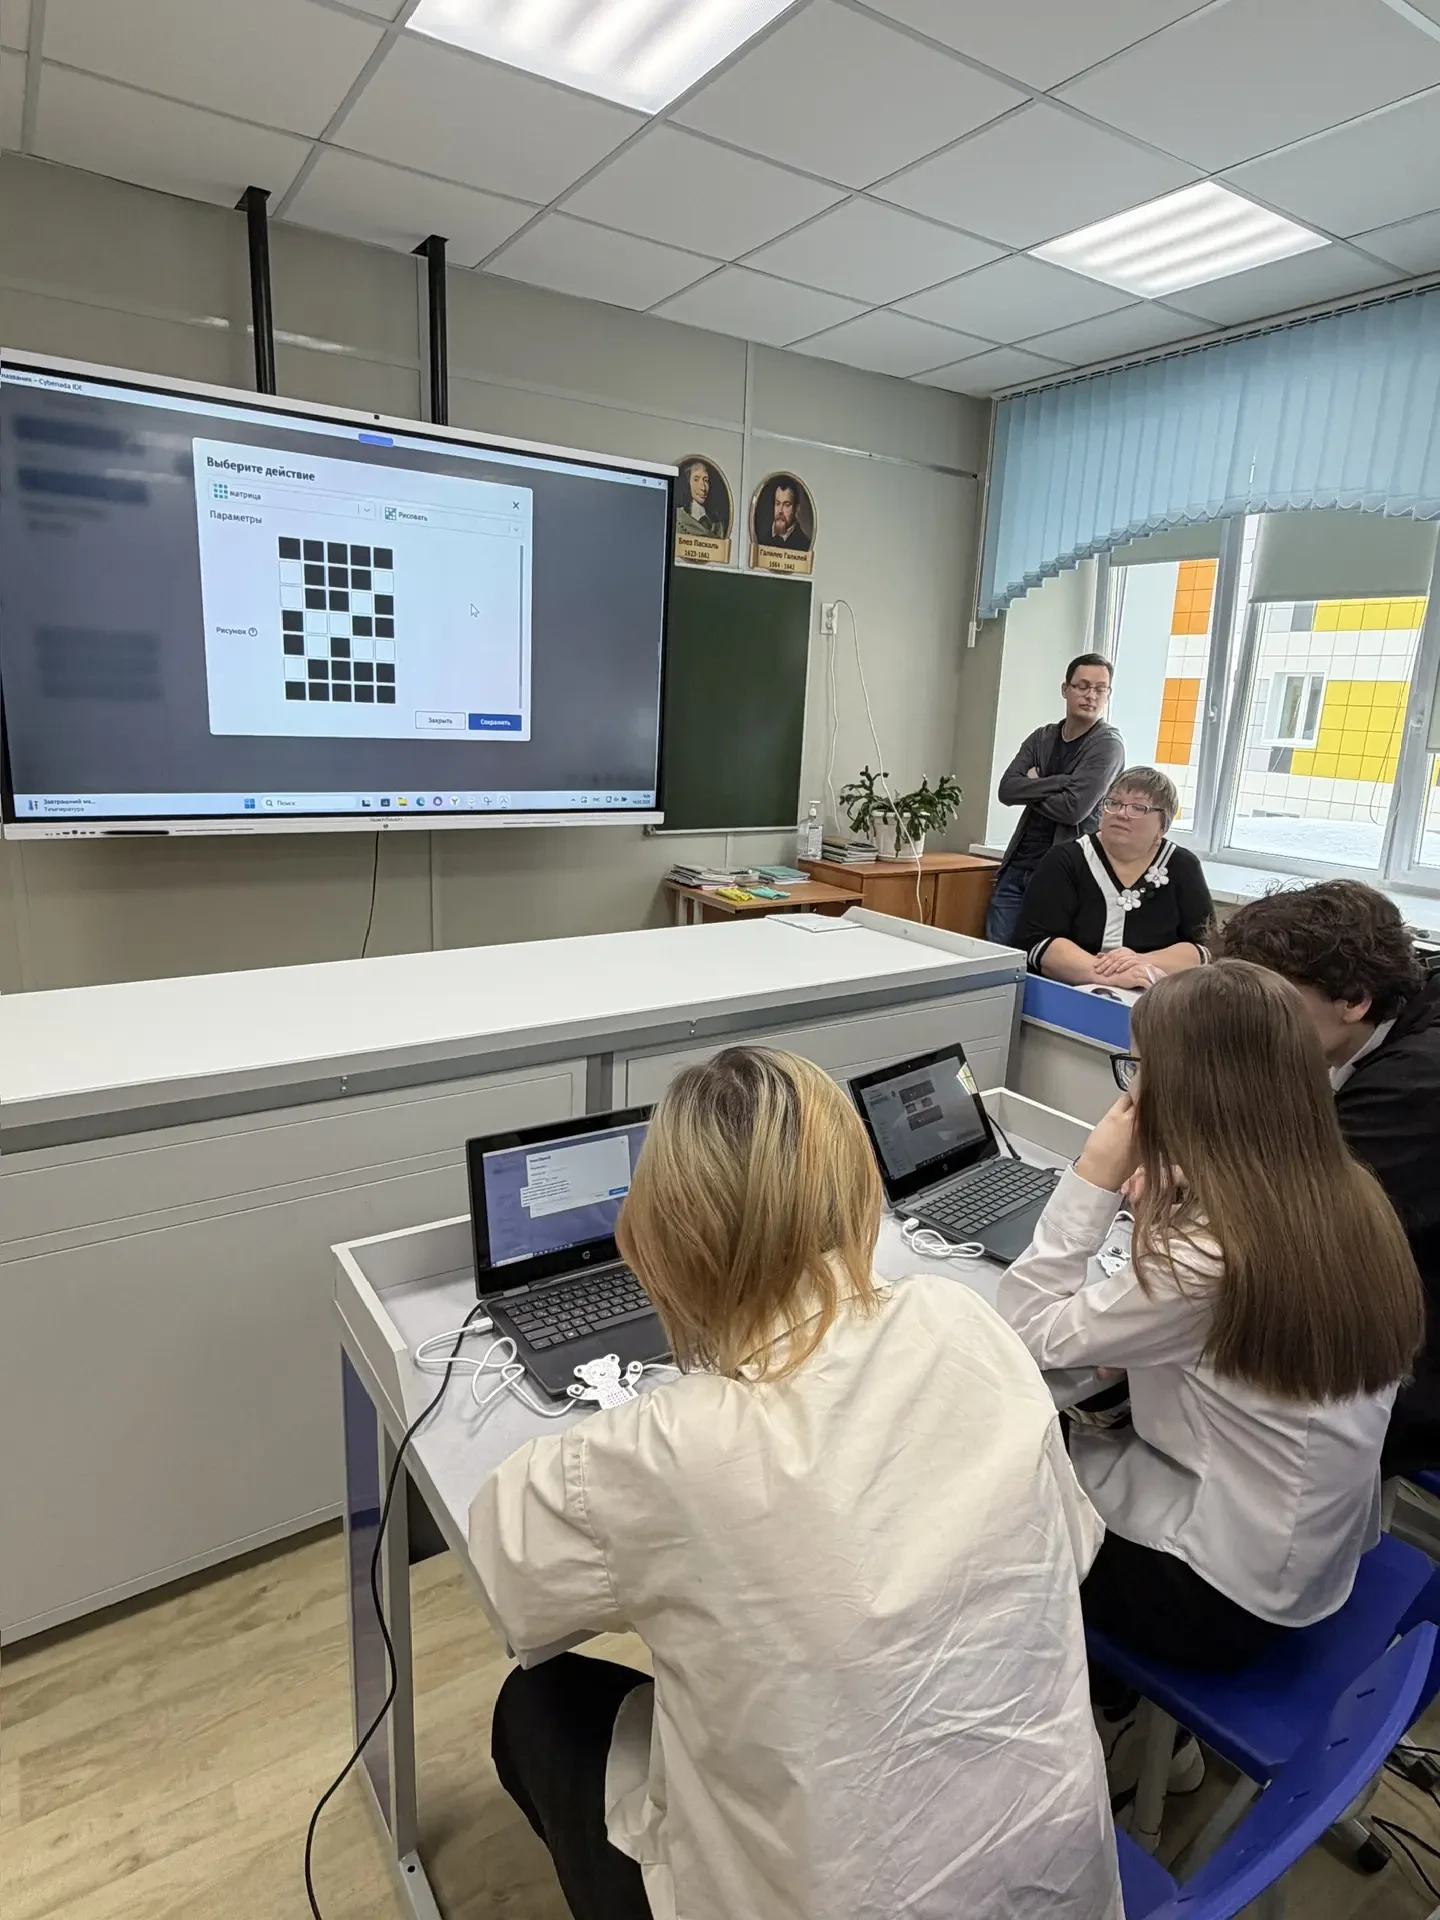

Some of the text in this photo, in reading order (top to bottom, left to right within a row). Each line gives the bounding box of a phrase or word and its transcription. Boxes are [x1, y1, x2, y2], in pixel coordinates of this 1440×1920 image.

[207, 457, 315, 481] Выберите действие
[230, 490, 262, 501] матрица
[209, 510, 263, 525] Параметры
[398, 511, 428, 522] Рисовать
[678, 537, 719, 550] Блез Паскаль
[759, 549, 808, 562] Галилео Галилей
[216, 626, 247, 635] Рисунок
[429, 717, 453, 725] Закрыть
